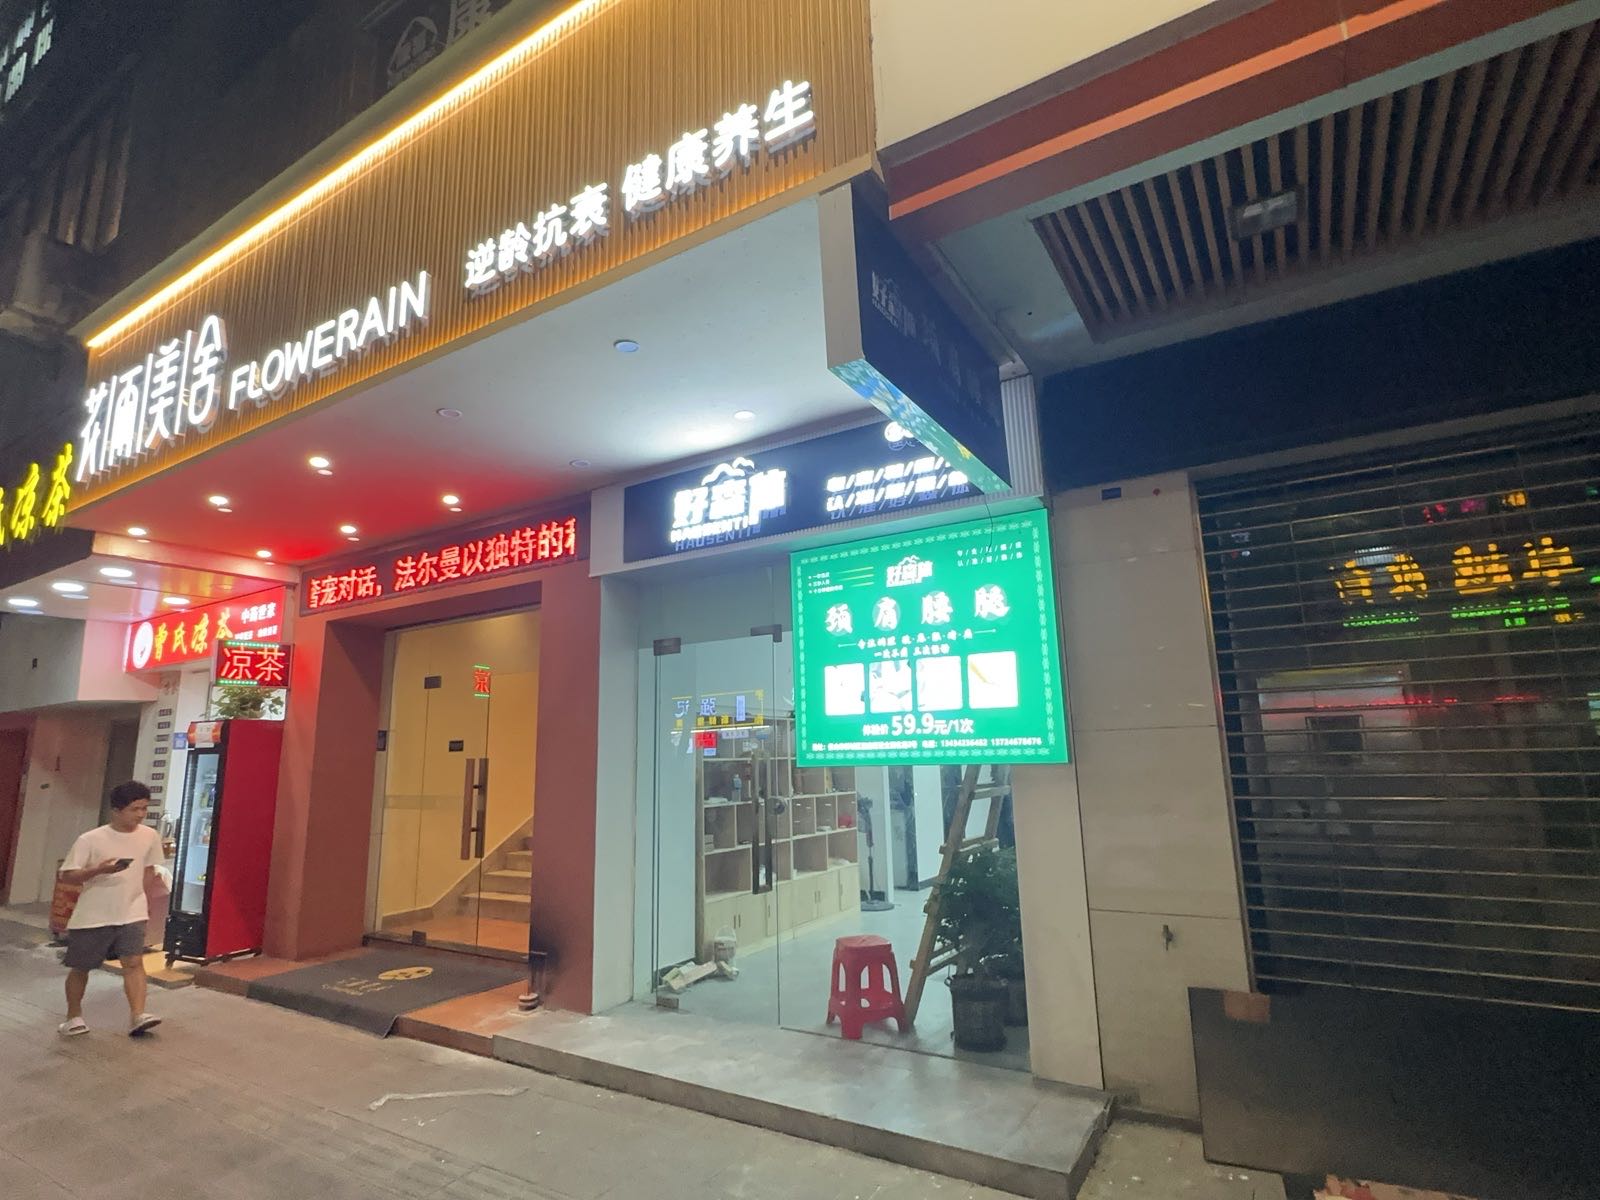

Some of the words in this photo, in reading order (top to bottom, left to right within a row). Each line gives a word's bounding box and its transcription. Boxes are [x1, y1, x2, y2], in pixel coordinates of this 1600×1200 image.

[465, 184, 608, 289] 逆龄抗衰
[622, 81, 814, 210] 健康养生
[229, 271, 430, 409] FLOWERAIN
[0, 443, 73, 547] 凉茶
[874, 596, 898, 630] 肩
[921, 591, 954, 625] 腰
[220, 646, 286, 681] 凉茶
[890, 712, 974, 737] 59.9元/1次
